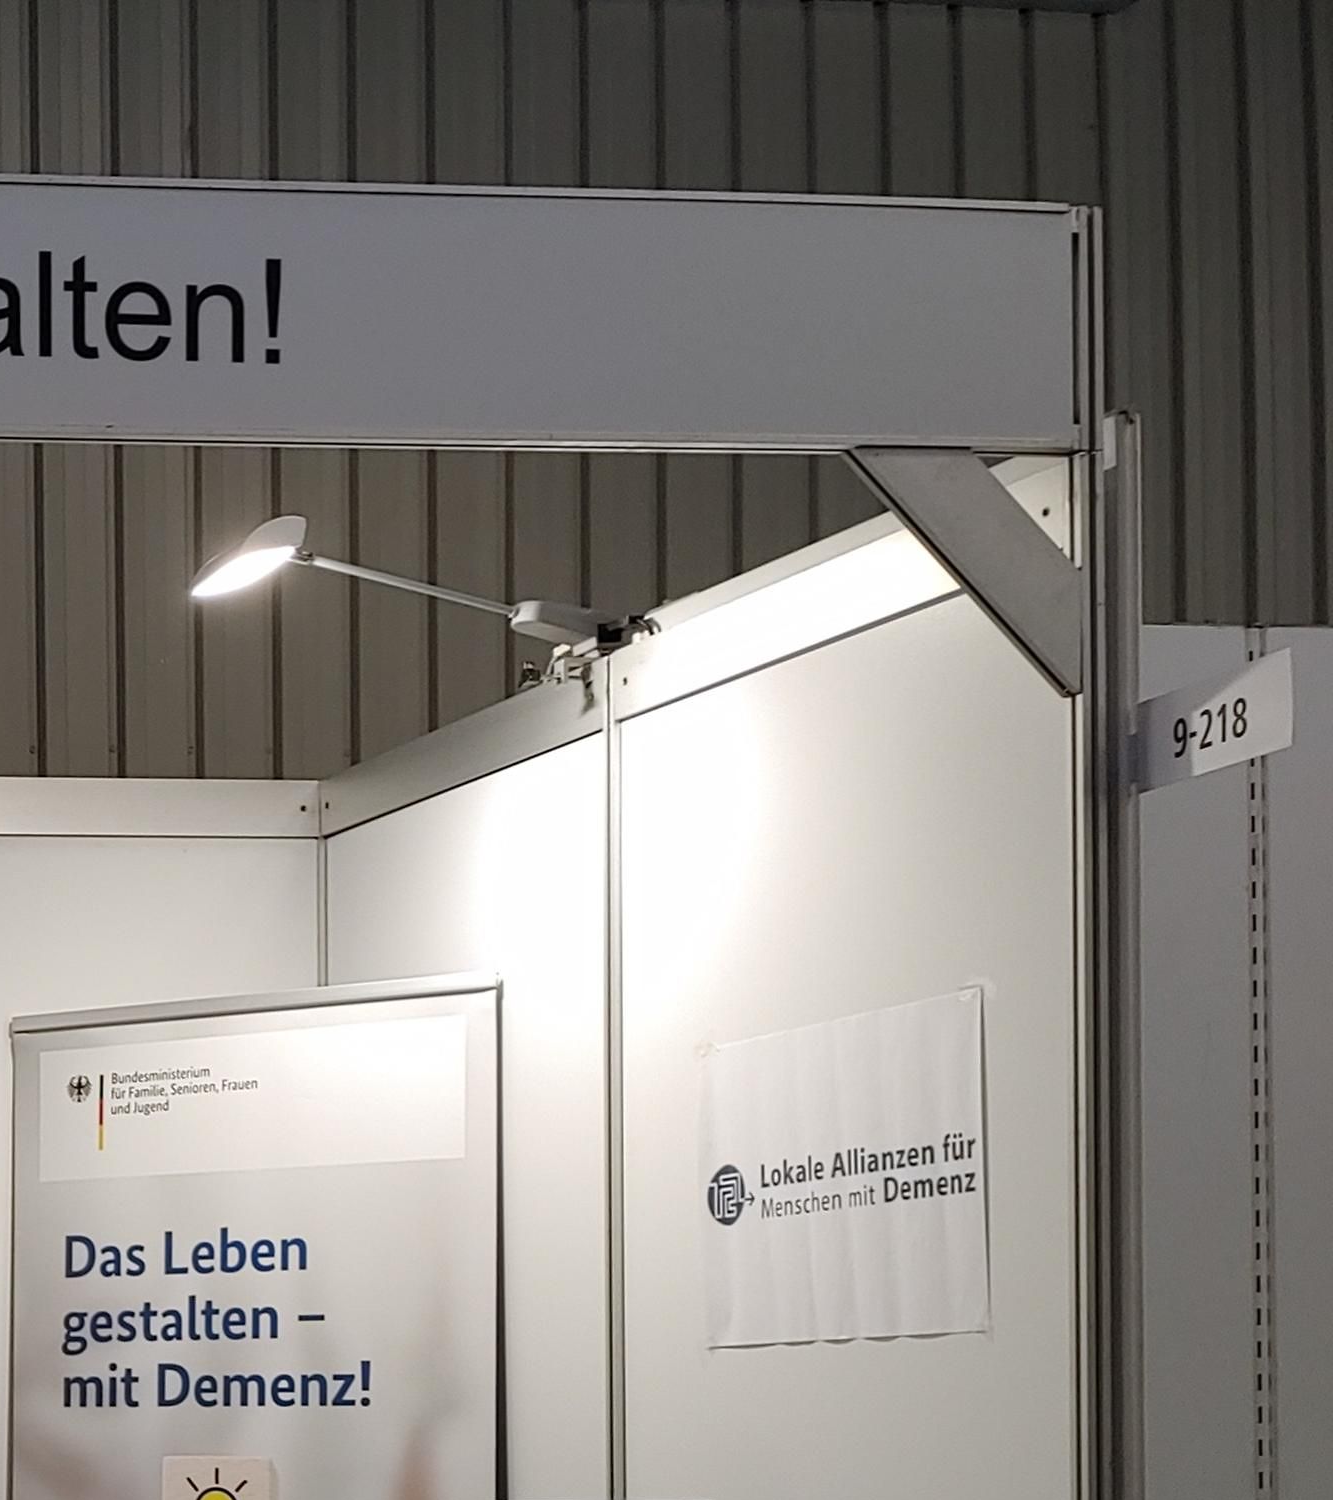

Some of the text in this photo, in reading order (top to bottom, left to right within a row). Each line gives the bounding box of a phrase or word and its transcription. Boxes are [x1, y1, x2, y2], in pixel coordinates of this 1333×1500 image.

[1173, 698, 1247, 758] 9-218
[111, 1066, 210, 1084] Bundesministerium
[111, 1079, 258, 1099] für Familie, Senioren, Frauen
[111, 1100, 169, 1115] und Jugend
[760, 1133, 976, 1188] Lokale Allianzen für
[761, 1171, 976, 1219] Menschen mit Demenz
[64, 1227, 308, 1278] Das Leben
[61, 1295, 278, 1356] gestalten
[63, 1360, 371, 1407] mit Demenz!
